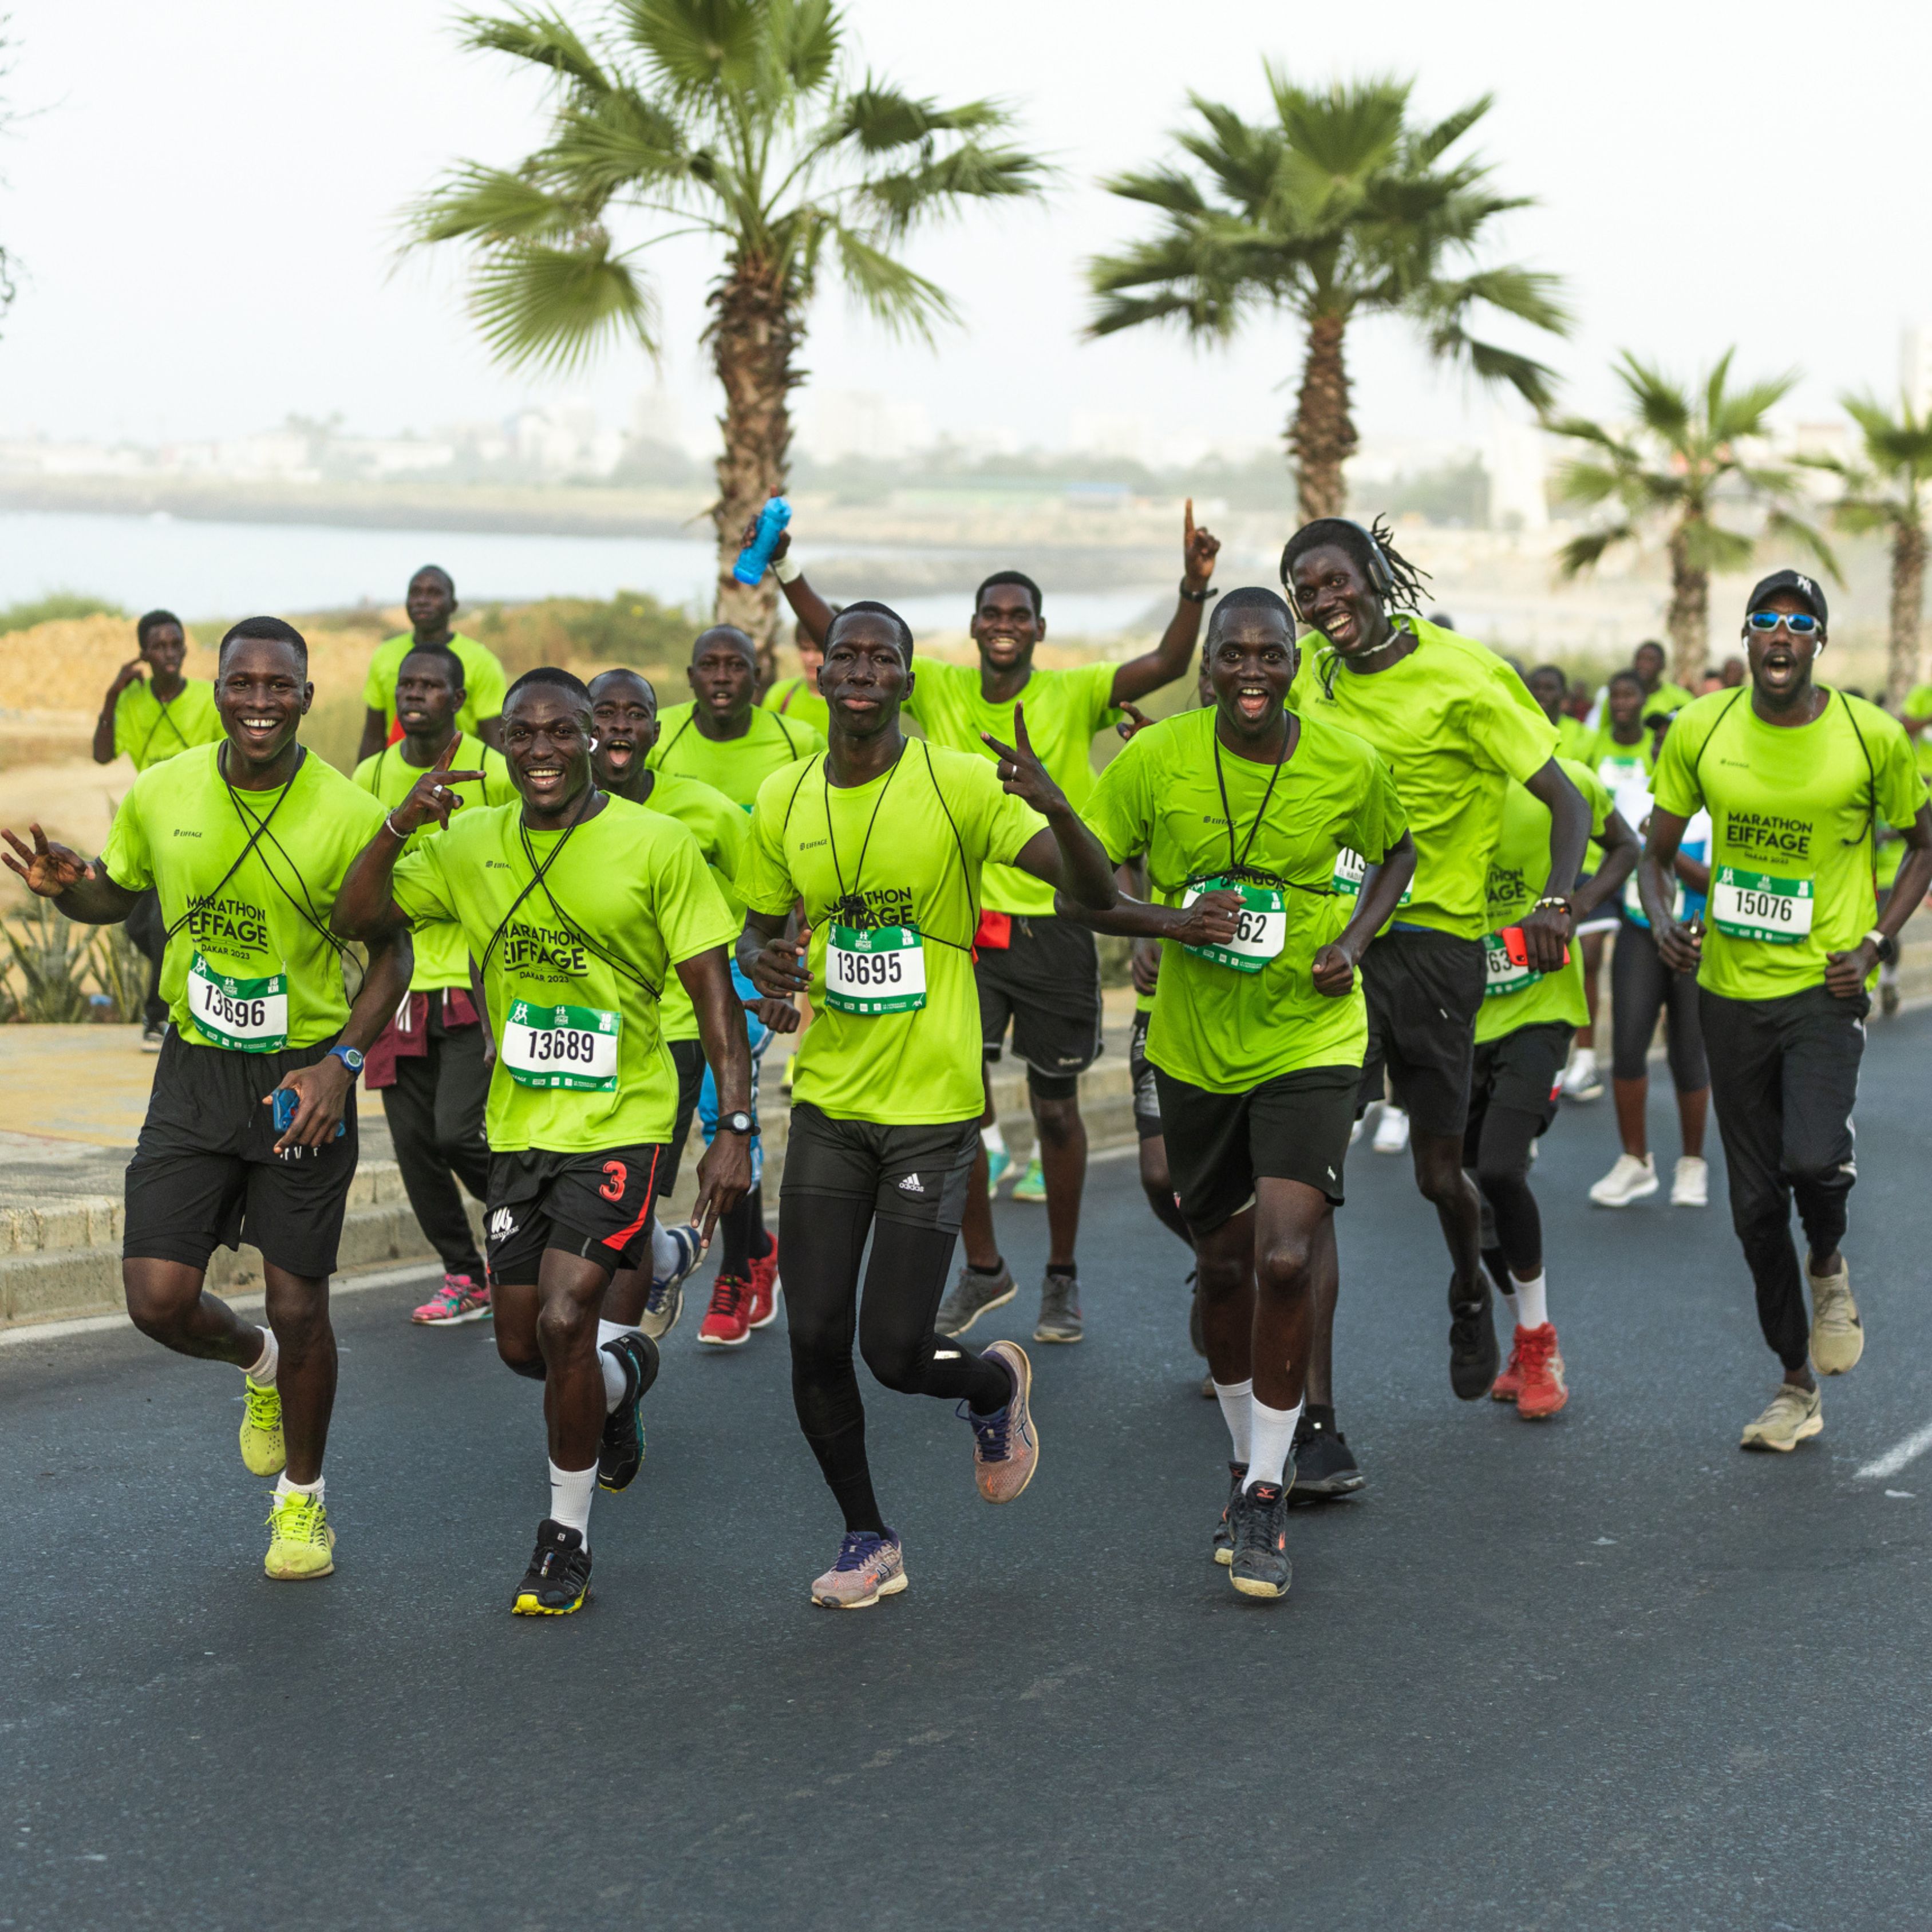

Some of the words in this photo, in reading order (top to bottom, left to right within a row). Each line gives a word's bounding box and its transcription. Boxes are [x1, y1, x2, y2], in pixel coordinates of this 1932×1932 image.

[1728, 811, 1812, 833] MARATHON
[1727, 825, 1810, 854] EIFFAGE
[187, 894, 266, 923] MARATHON
[1736, 889, 1792, 922] 15076
[500, 922, 583, 946] MARATHON
[1237, 911, 1267, 943] 62
[202, 944, 228, 955] DAKAR
[231, 949, 250, 960] 2023
[504, 939, 587, 970] EIFFAGE
[1488, 950, 1512, 973] 63
[519, 971, 545, 982] DAKAR
[547, 975, 569, 983] 2023
[837, 951, 902, 985] 13695
[205, 984, 266, 1028] 13696
[528, 1029, 594, 1063] 13689
[599, 1160, 627, 1202] 3
[899, 1182, 924, 1192] adidas
